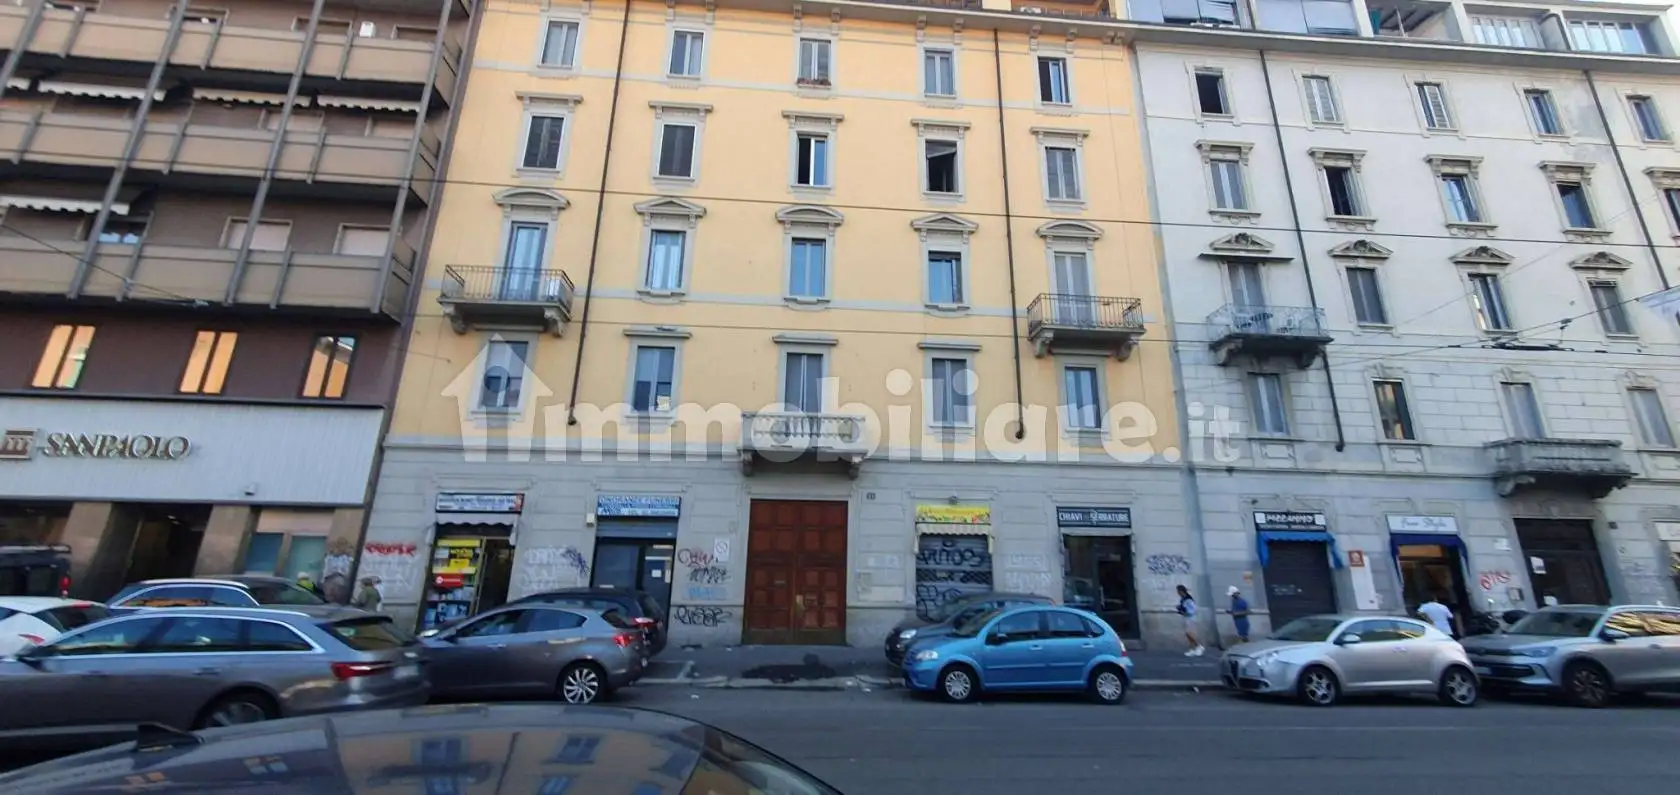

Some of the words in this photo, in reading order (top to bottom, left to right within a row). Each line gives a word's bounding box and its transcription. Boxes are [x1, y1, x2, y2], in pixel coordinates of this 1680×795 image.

[43, 431, 192, 460] SANPAOLO
[1059, 512, 1083, 521] CHIAVI
[1090, 511, 1129, 522] SERRATURE
